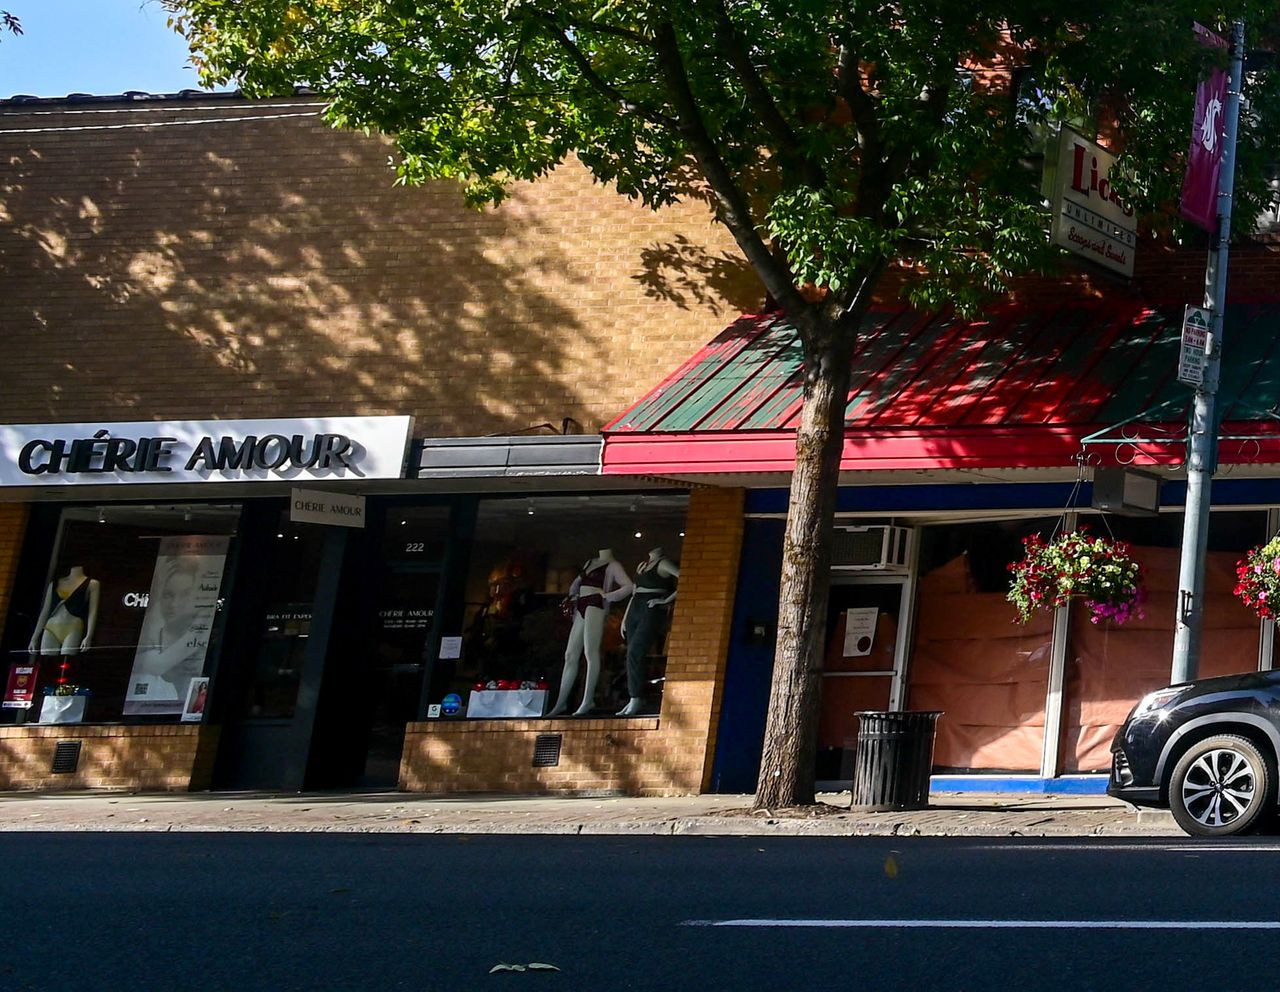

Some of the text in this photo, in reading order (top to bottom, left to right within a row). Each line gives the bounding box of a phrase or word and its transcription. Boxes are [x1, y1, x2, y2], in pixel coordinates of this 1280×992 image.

[18, 429, 350, 475] CHÉRIE AMOUR
[330, 504, 362, 516] AMOUR
[405, 542, 425, 552] 222
[407, 609, 434, 617] AMOUR
